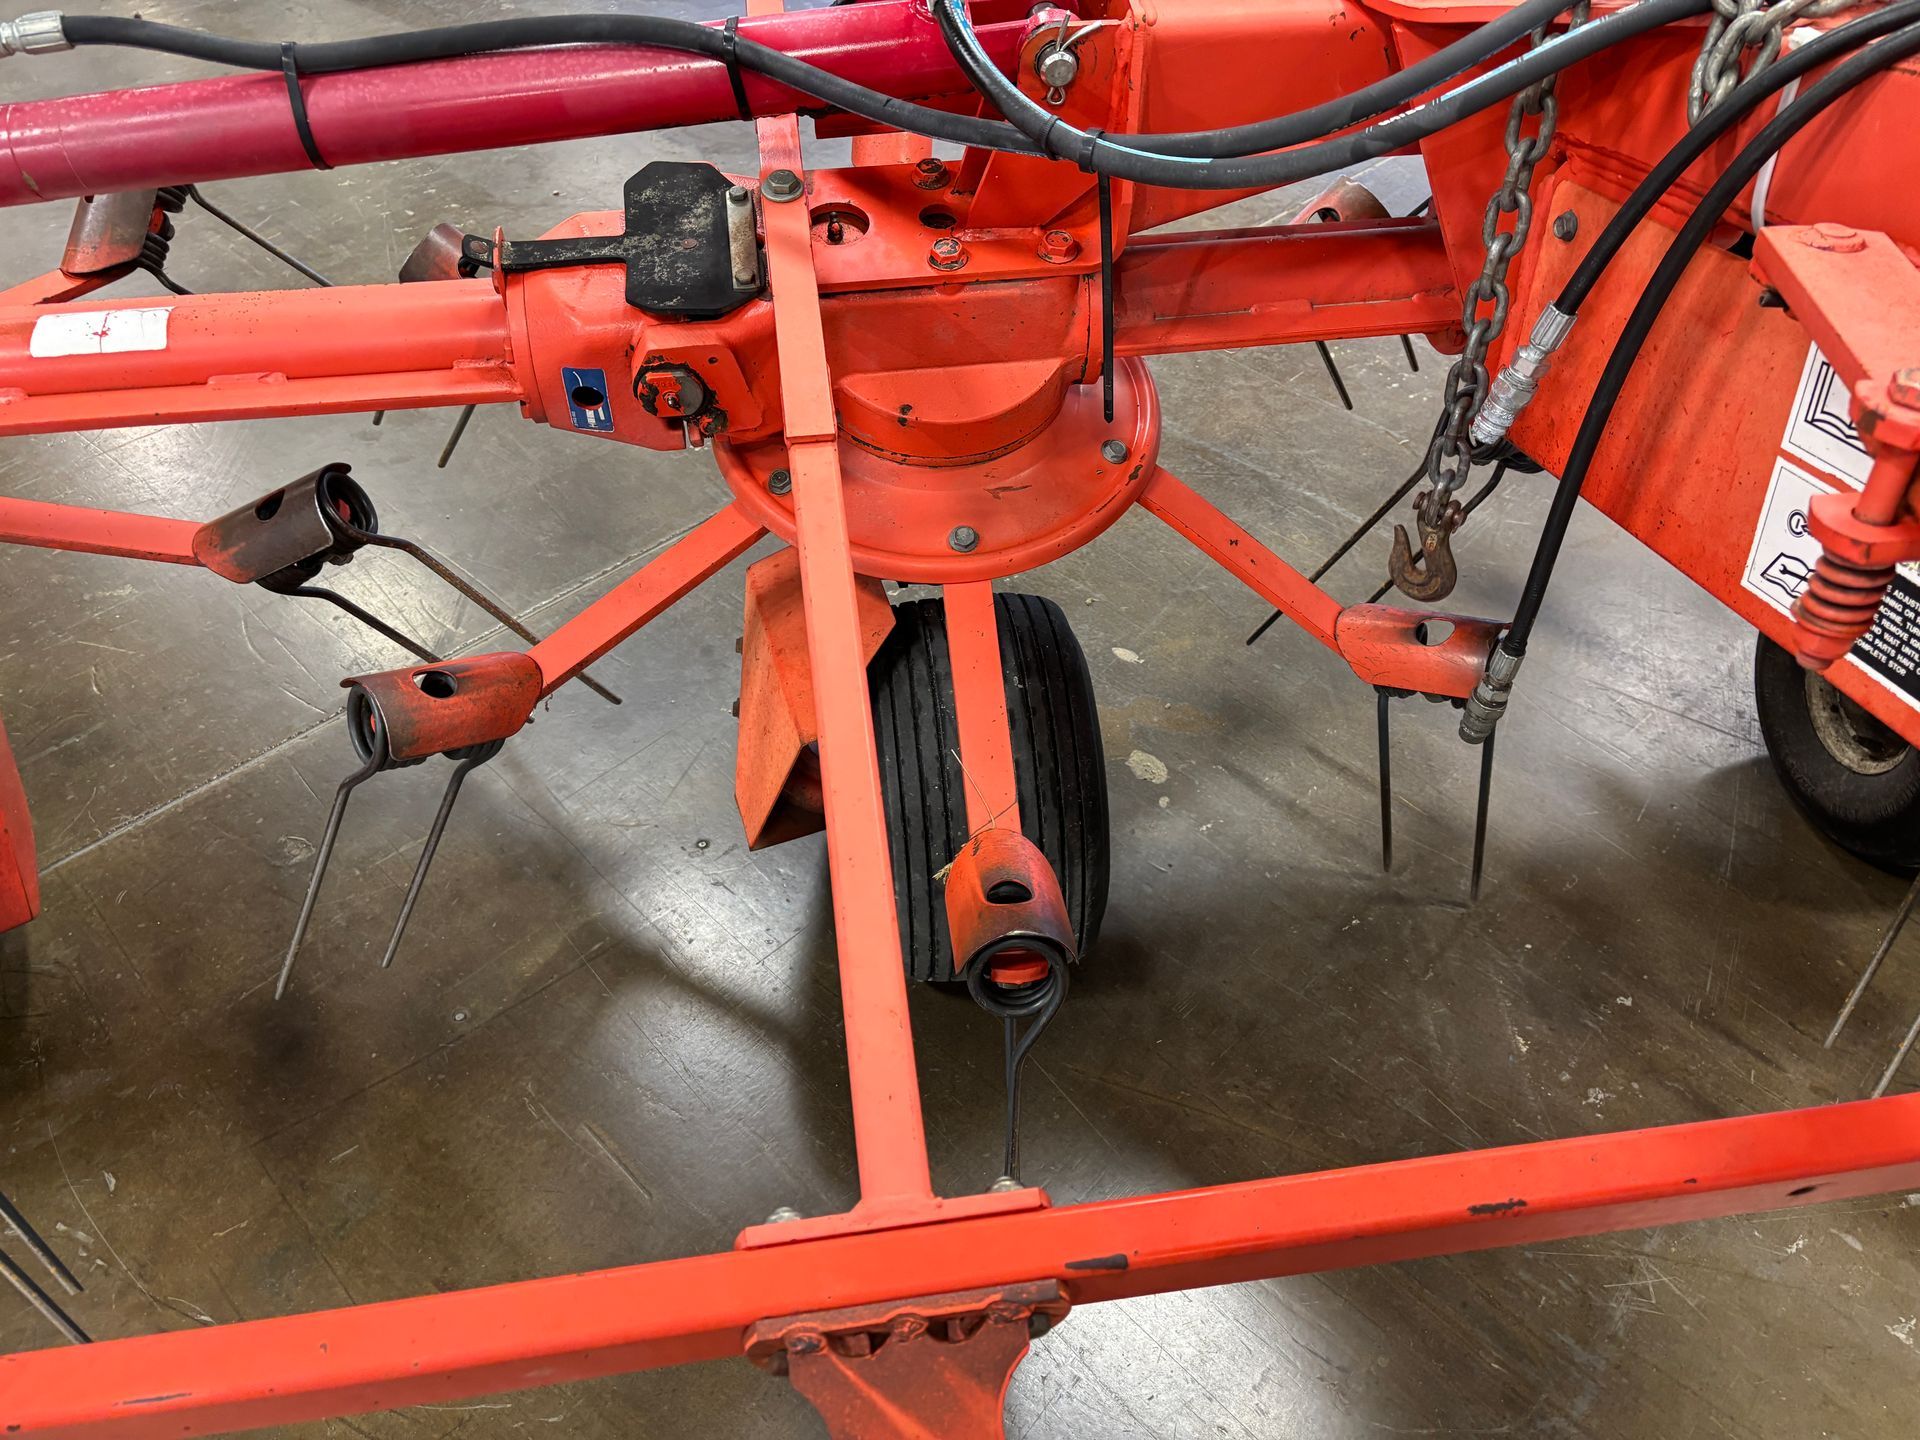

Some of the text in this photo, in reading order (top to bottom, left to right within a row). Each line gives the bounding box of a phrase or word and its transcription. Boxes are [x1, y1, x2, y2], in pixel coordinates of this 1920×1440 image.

[1878, 605, 1903, 626] ACHINE,
[1904, 609, 1915, 620] OR
[1881, 618, 1909, 641] REMOVE
[1874, 638, 1896, 657] PARTS
[1897, 654, 1915, 671] HAVE
[1884, 632, 1901, 647] WAIT
[1901, 644, 1920, 662] UNTIL
